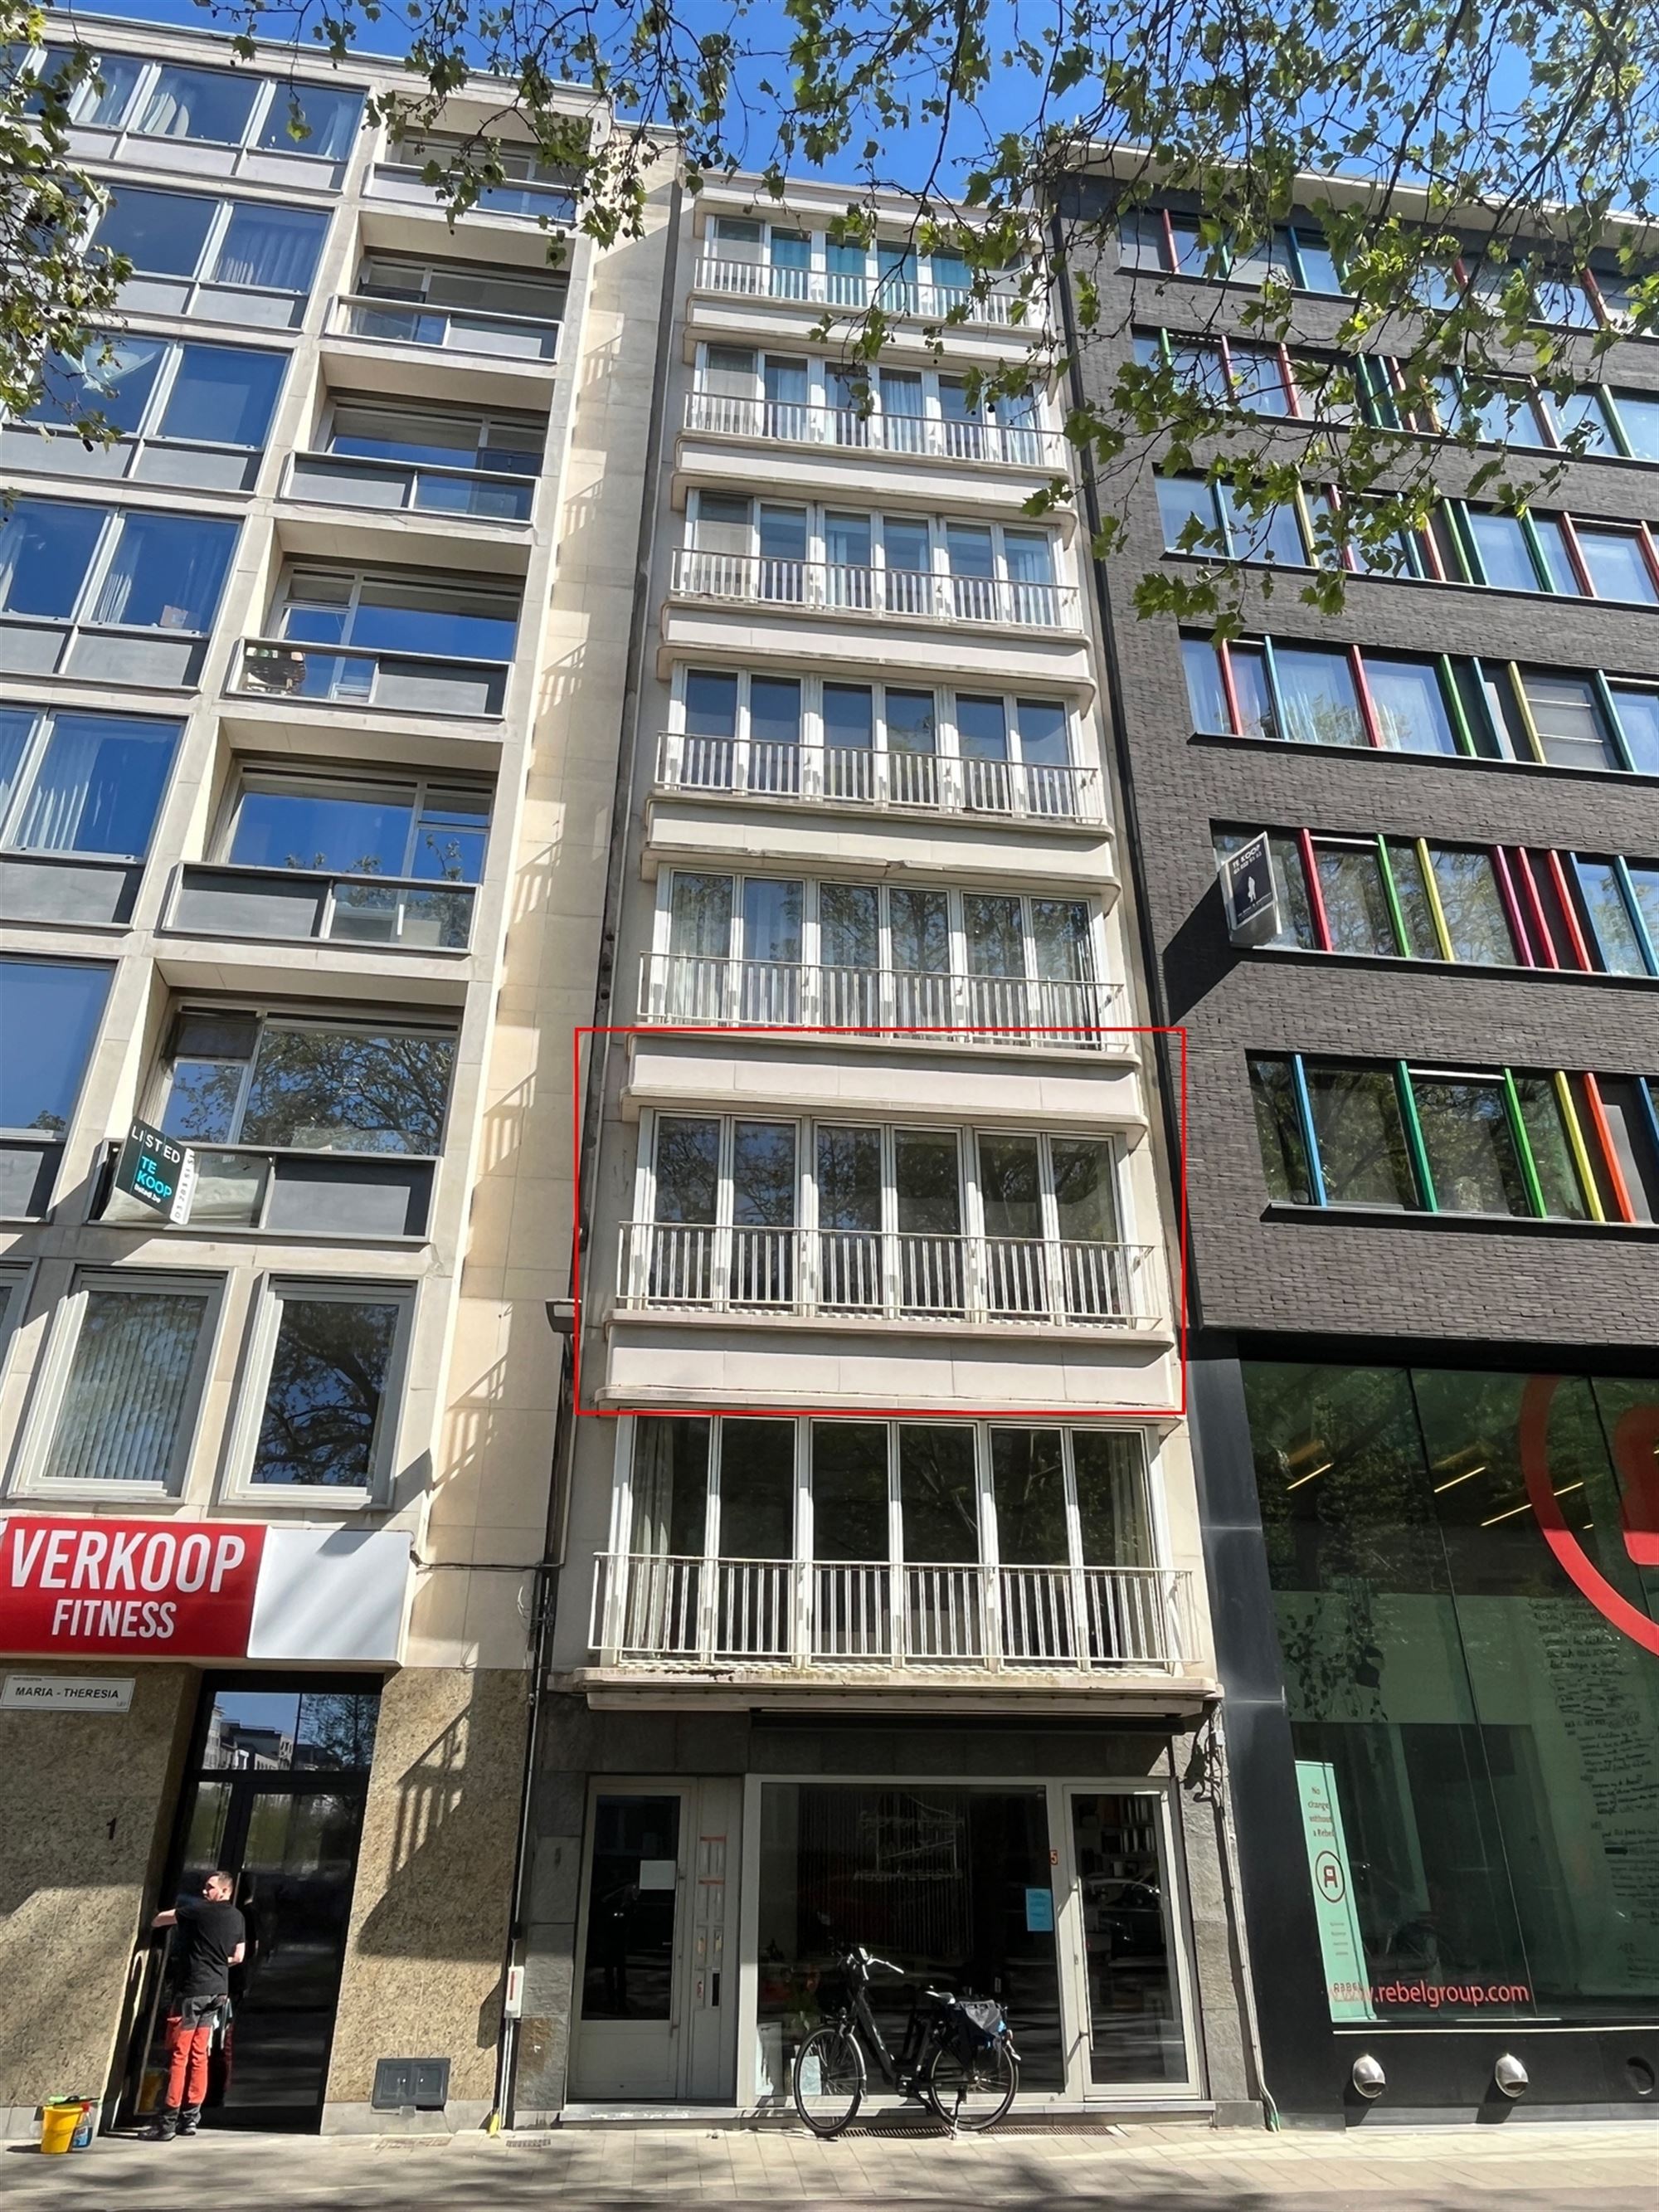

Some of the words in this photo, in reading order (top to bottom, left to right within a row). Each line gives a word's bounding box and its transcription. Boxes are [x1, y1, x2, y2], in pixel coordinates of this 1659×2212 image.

[131, 1125, 180, 1163] LISTED
[141, 1156, 158, 1175] TE
[137, 1171, 173, 1198] KOOP
[12, 1528, 246, 1593] VERKOOP
[51, 1599, 177, 1639] FITNESS
[15, 1687, 54, 1697] MARIA
[64, 1688, 119, 1698] THERESIA
[106, 1817, 117, 1840] 1
